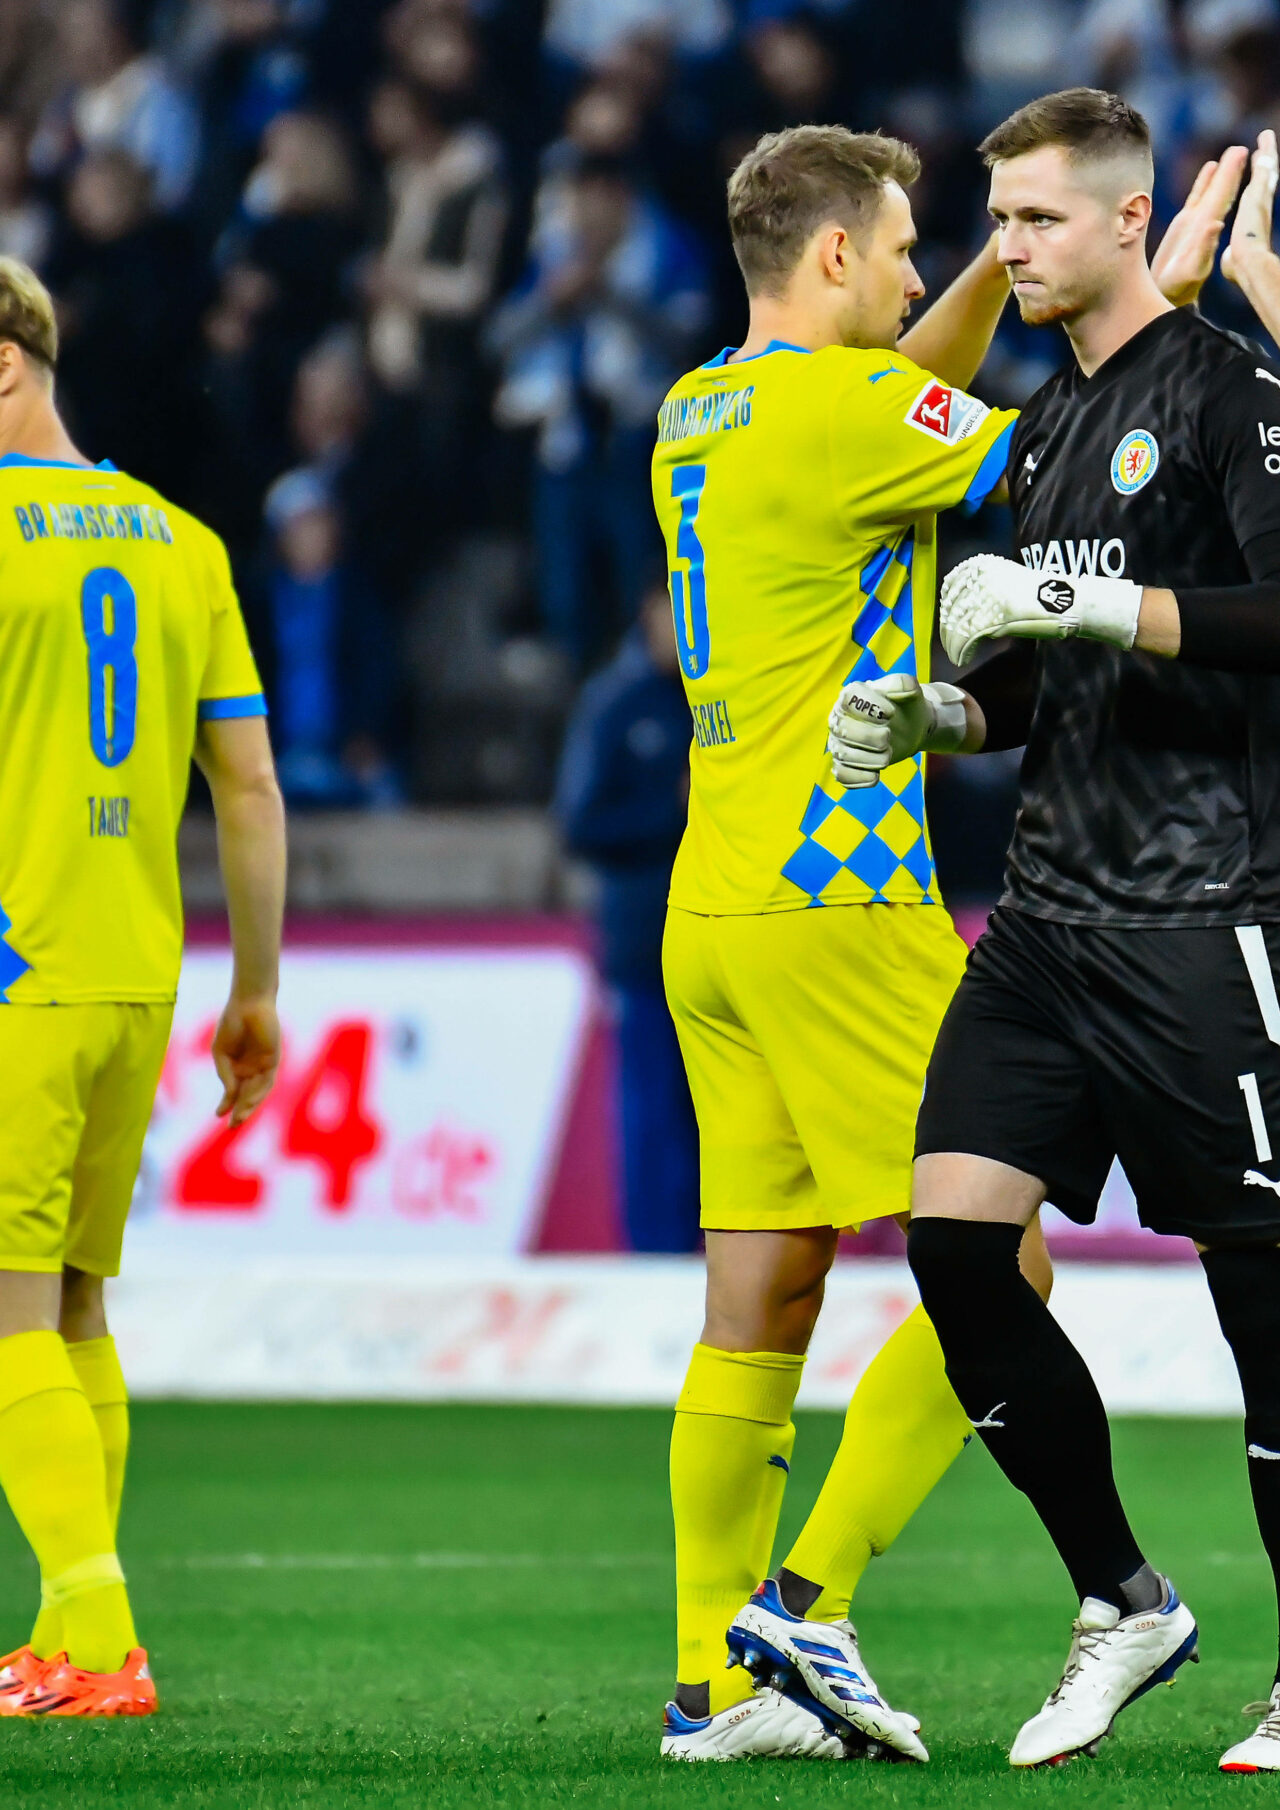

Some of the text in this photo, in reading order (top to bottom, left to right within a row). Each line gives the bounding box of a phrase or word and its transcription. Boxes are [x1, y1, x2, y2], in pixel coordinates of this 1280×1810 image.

[657, 386, 755, 443] RAUNSCHWEIG
[671, 464, 711, 680] 3
[80, 566, 137, 768] 8
[693, 699, 736, 748] ECKEL
[1237, 1072, 1273, 1163] 1
